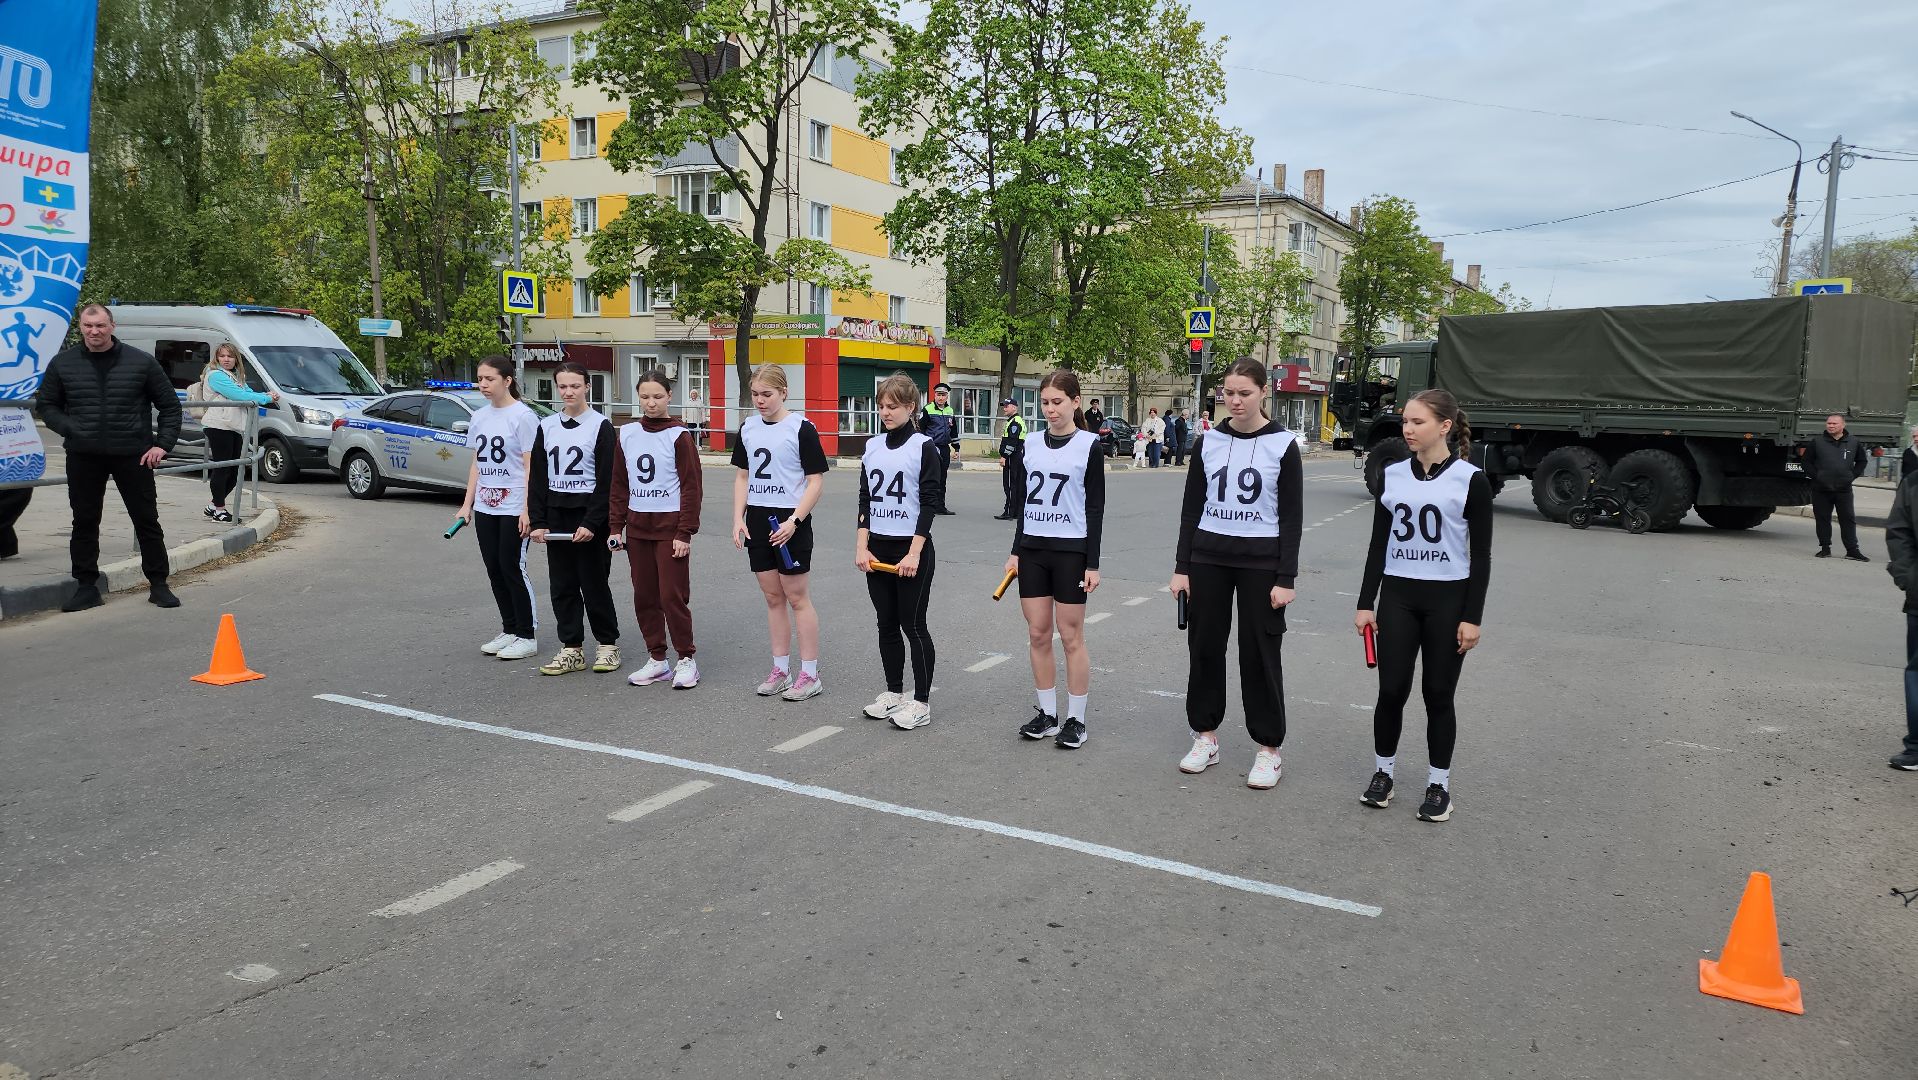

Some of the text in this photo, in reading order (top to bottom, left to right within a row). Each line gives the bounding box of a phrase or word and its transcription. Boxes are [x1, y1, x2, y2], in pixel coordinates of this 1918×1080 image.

[842, 320, 880, 339] ОВОЩИ
[889, 325, 929, 342] ФРУКТЫ
[434, 432, 467, 445] ПОЛИЦИЯ
[476, 434, 506, 463] 28
[390, 455, 407, 469] 112
[479, 467, 510, 476] ШИРА
[549, 446, 584, 475] 12
[637, 454, 655, 484] 9
[754, 448, 771, 479] 2
[550, 480, 588, 489] АШИРА
[630, 489, 669, 497] АШИРА
[870, 469, 906, 504] 24
[1027, 471, 1070, 506] 27
[1211, 466, 1262, 504] 19
[1206, 506, 1263, 521] КАШИРА
[1393, 503, 1442, 543] 30
